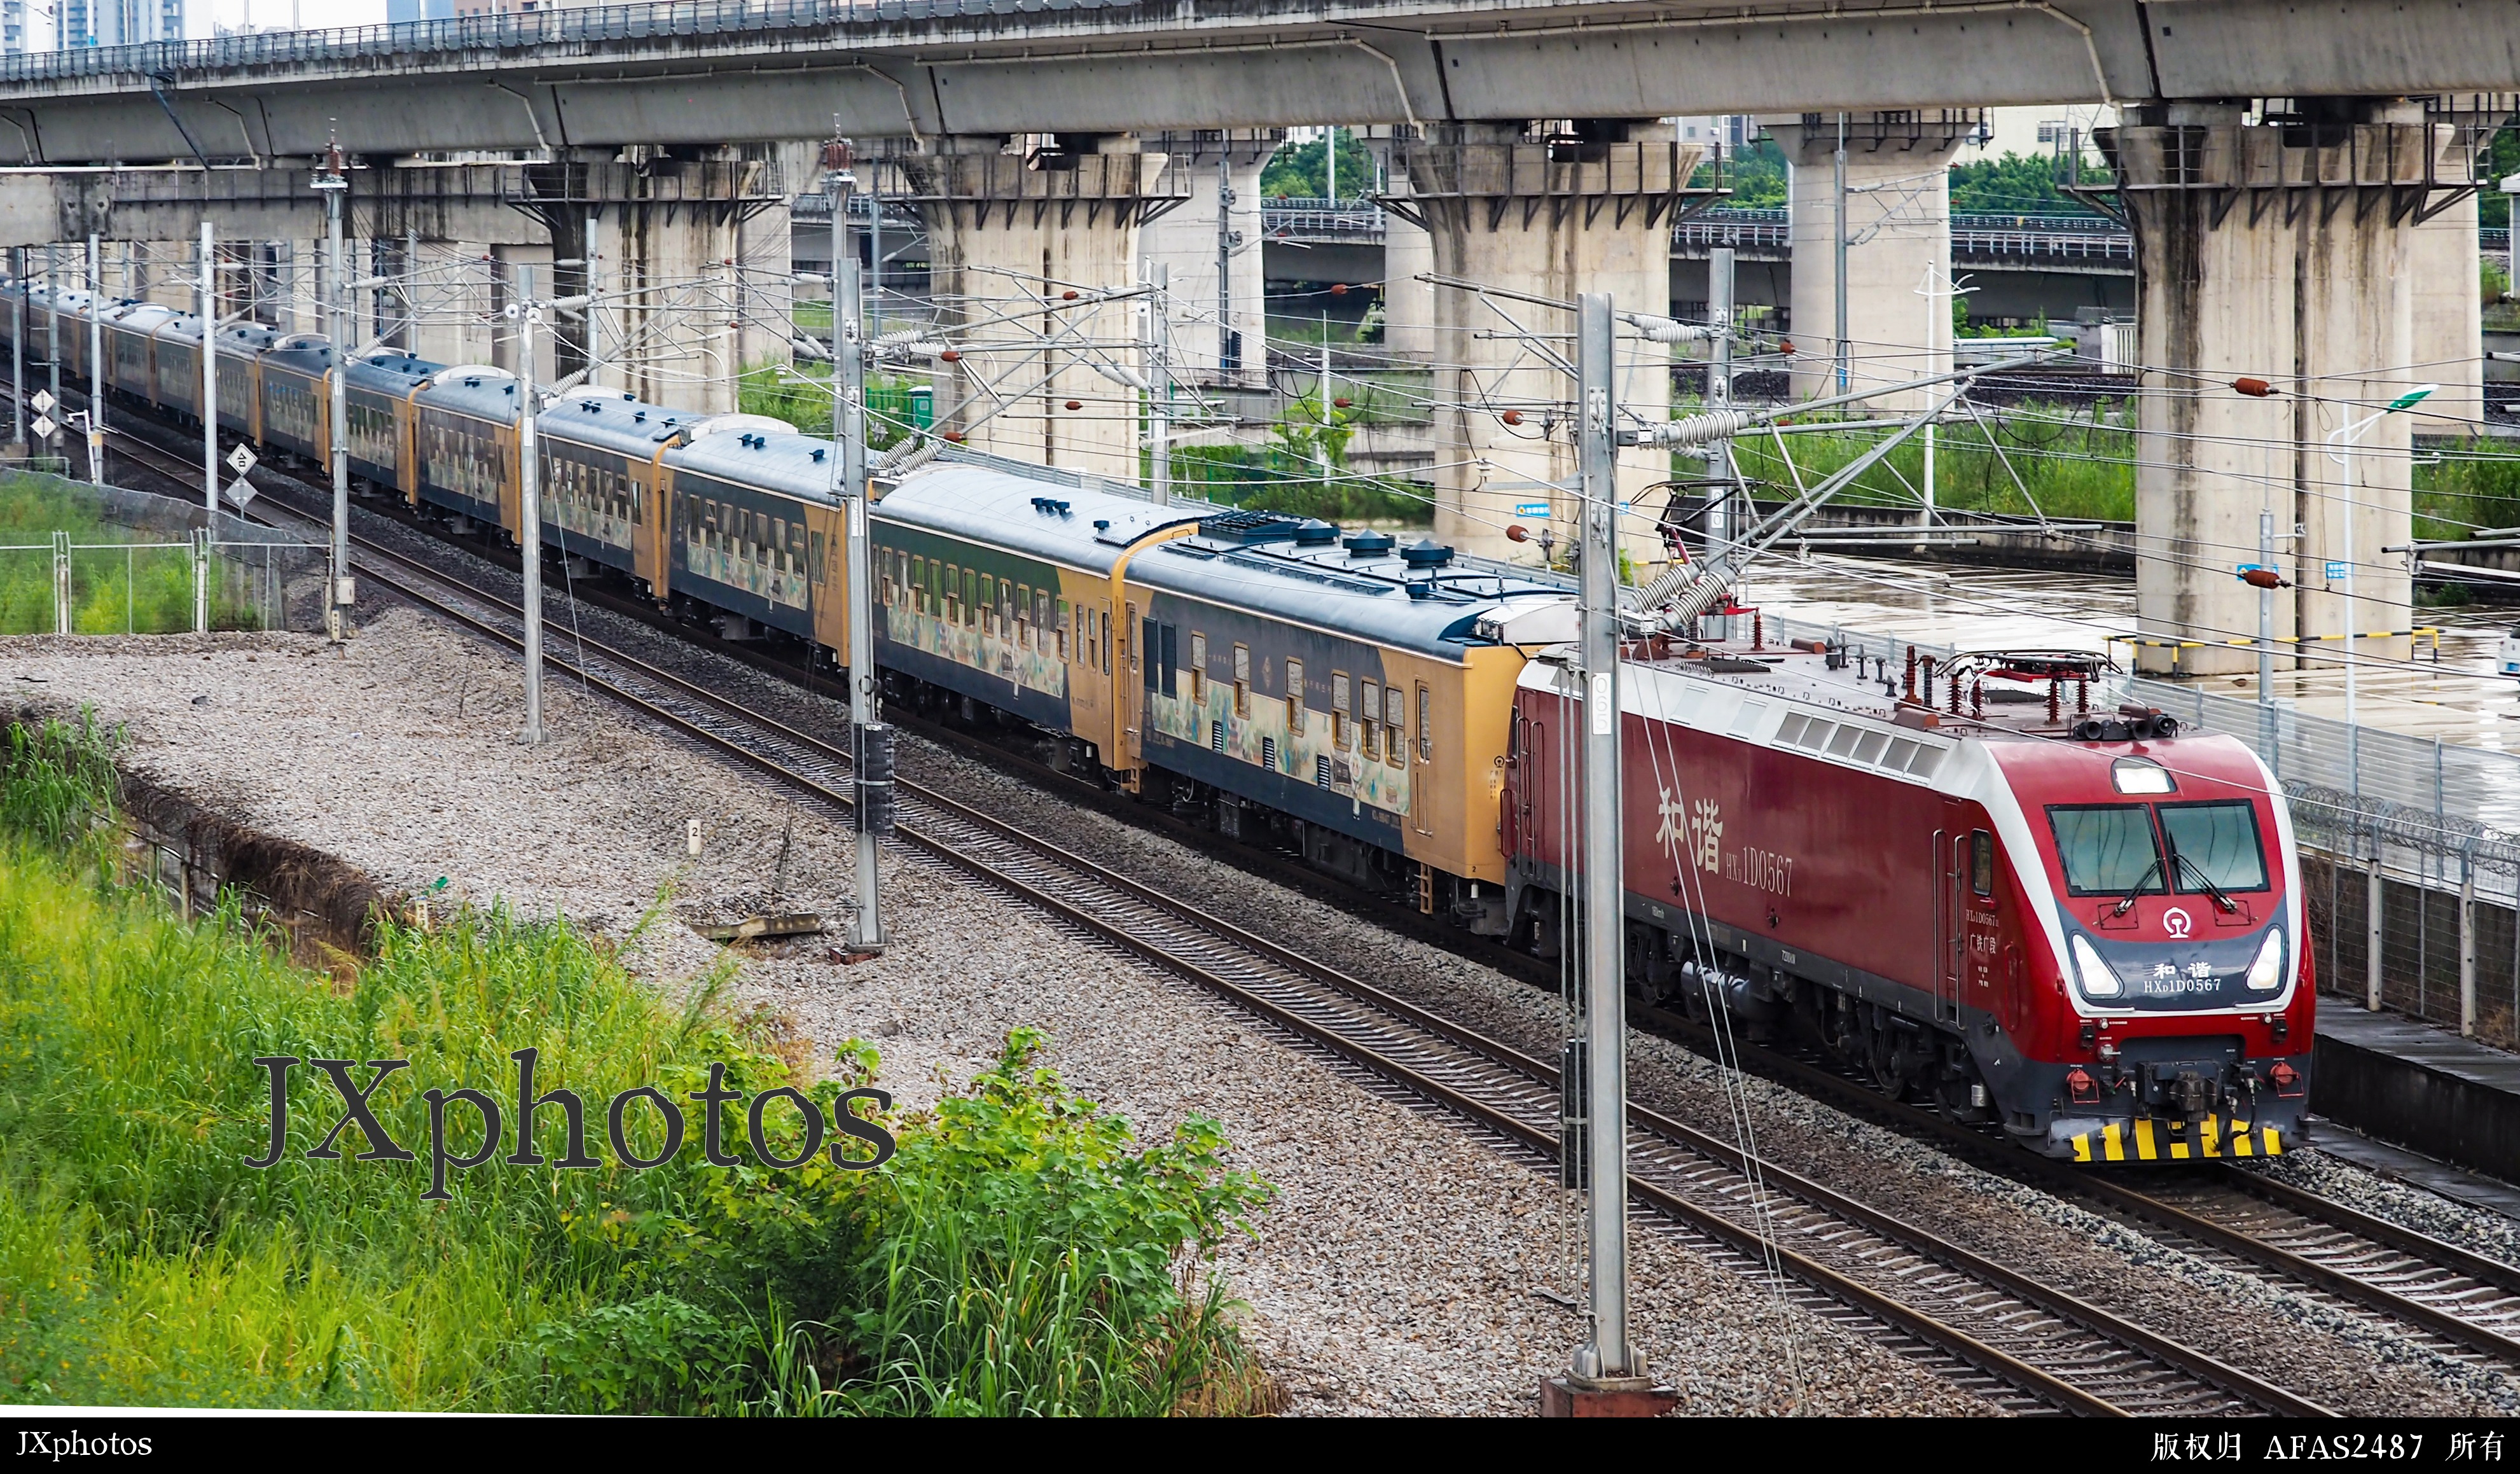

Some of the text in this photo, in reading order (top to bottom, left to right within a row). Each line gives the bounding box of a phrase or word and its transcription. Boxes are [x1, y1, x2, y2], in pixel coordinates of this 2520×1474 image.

[237, 452, 246, 467] 合
[1596, 678, 1607, 730] 065
[692, 827, 698, 837] 2
[1656, 786, 1723, 875] 和谐
[2153, 961, 2212, 980] 和谐
